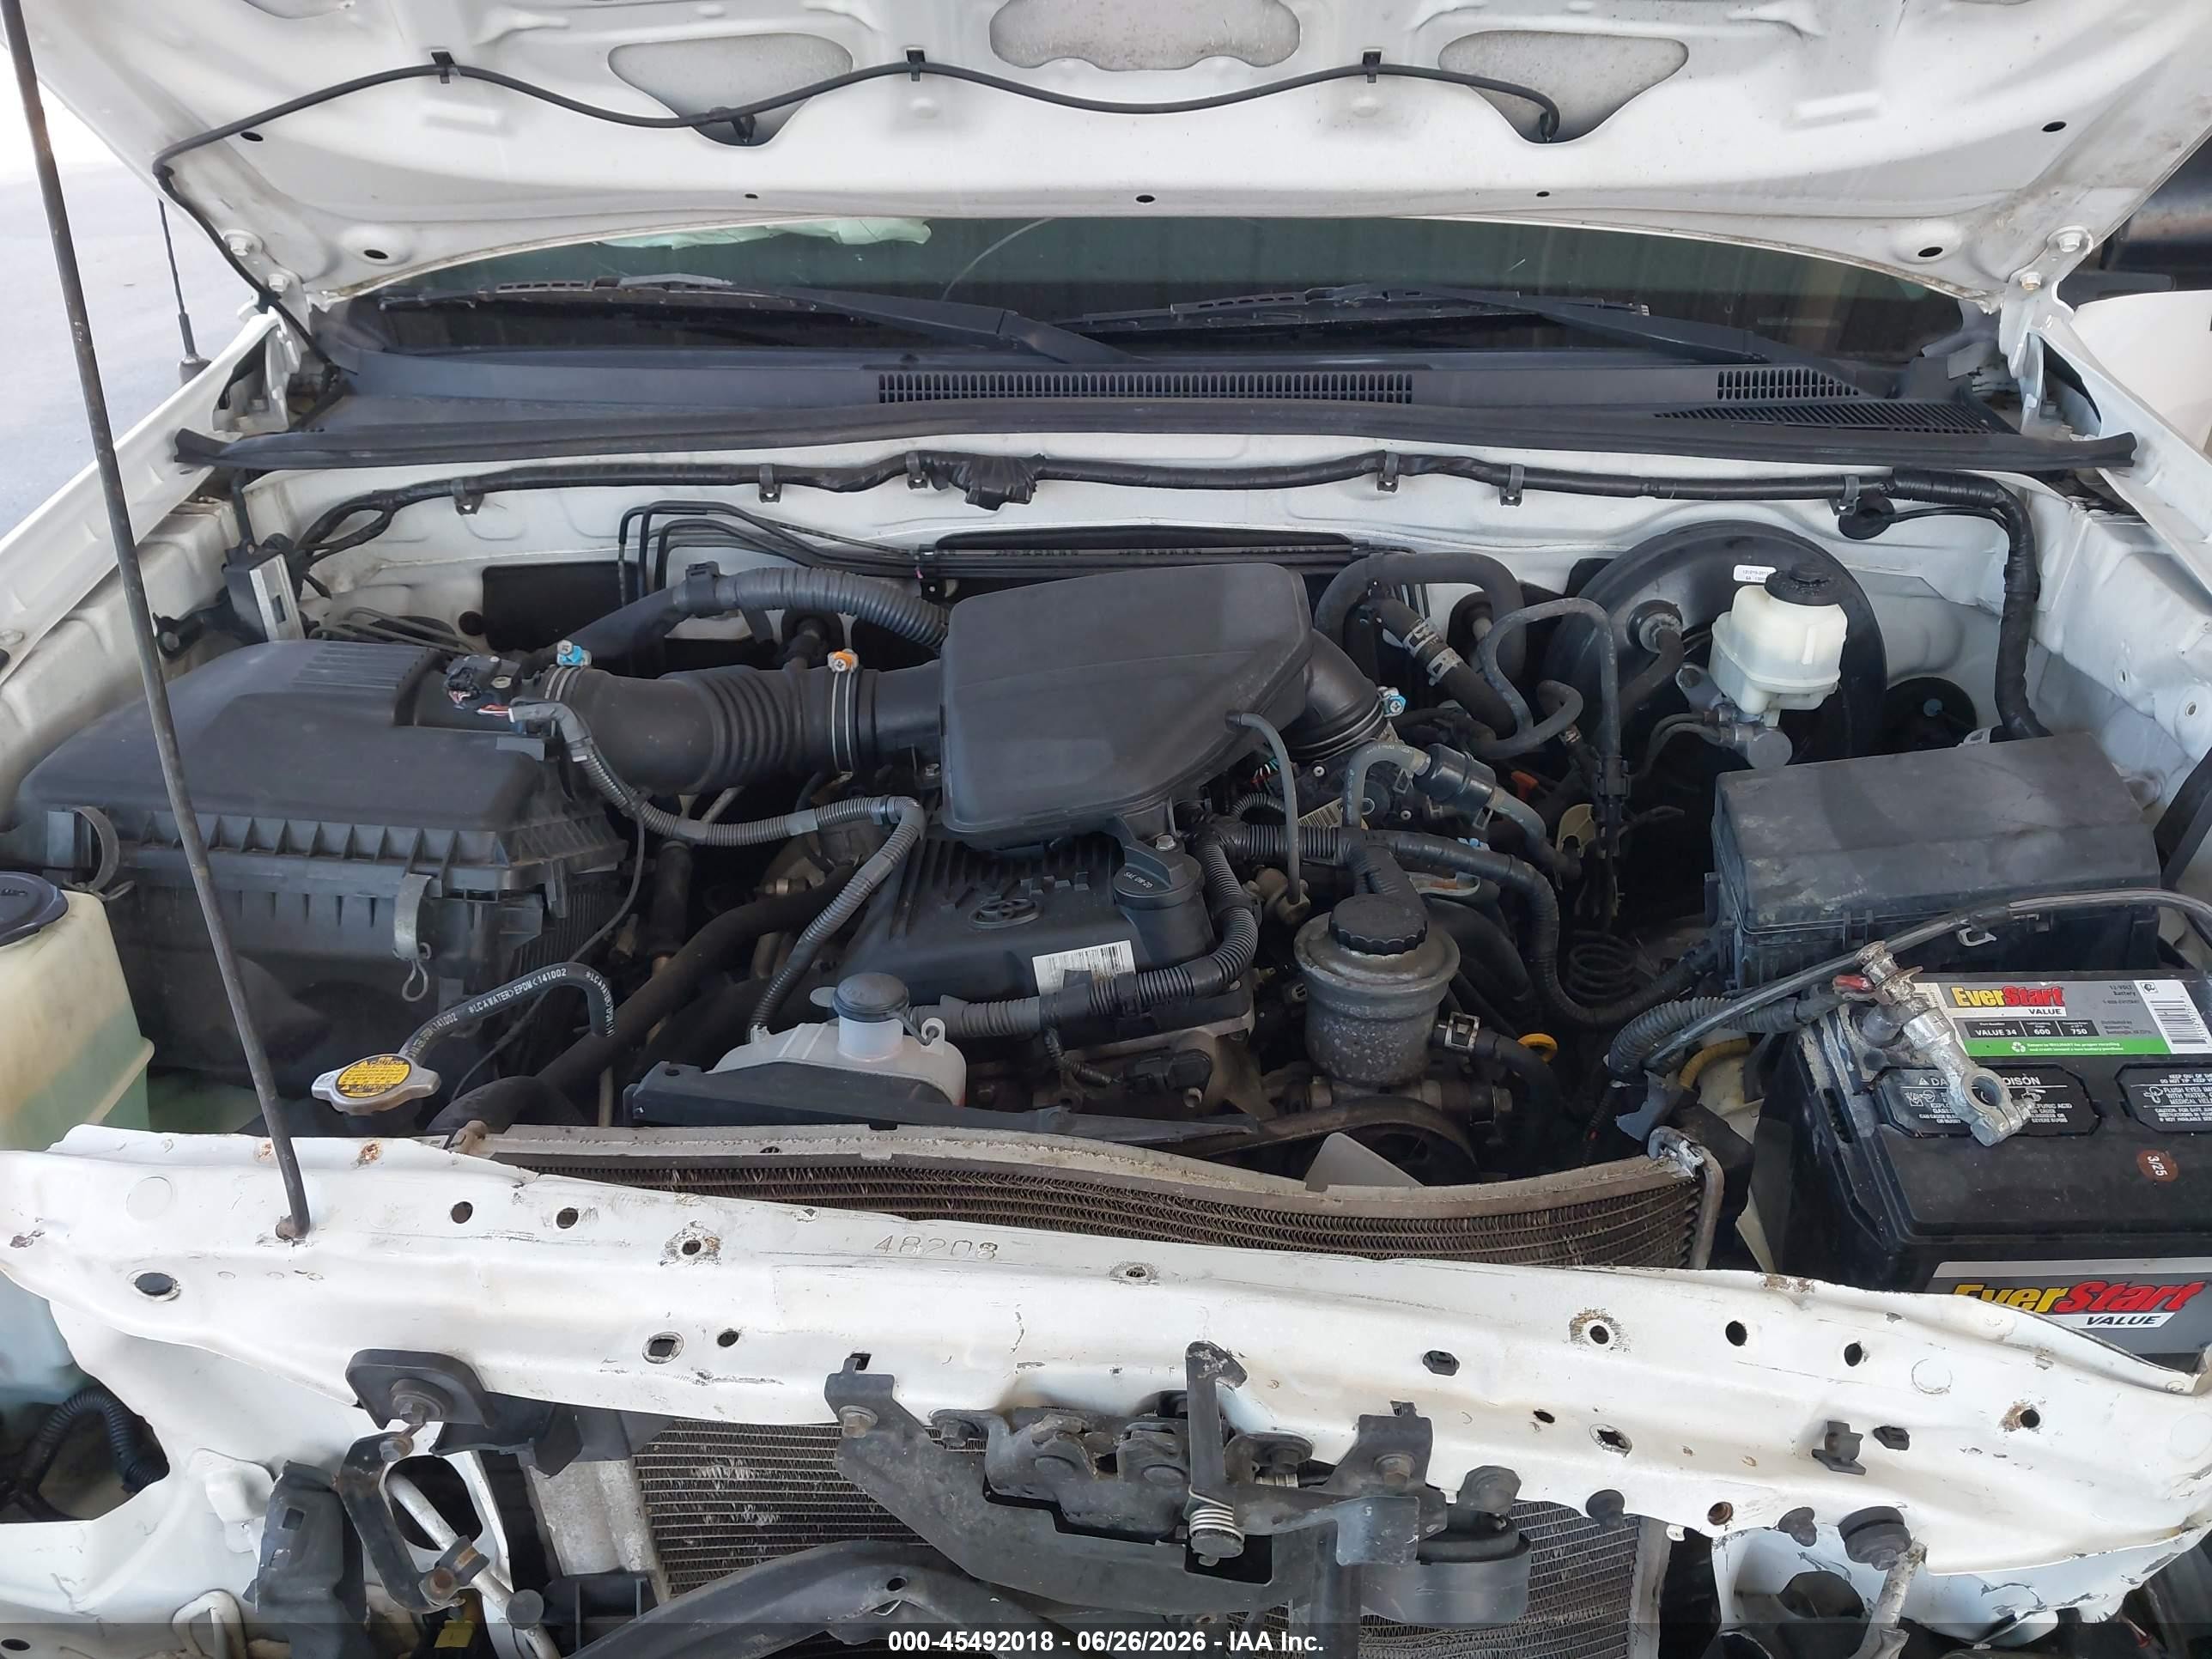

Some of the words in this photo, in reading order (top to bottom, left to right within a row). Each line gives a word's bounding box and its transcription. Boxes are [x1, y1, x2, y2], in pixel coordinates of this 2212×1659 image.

[1951, 986, 2065, 1007] EverStart
[2003, 1077, 2041, 1085] OISON
[2147, 1155, 2168, 1176] 3/25
[2087, 1315, 2160, 1327] VALUE
